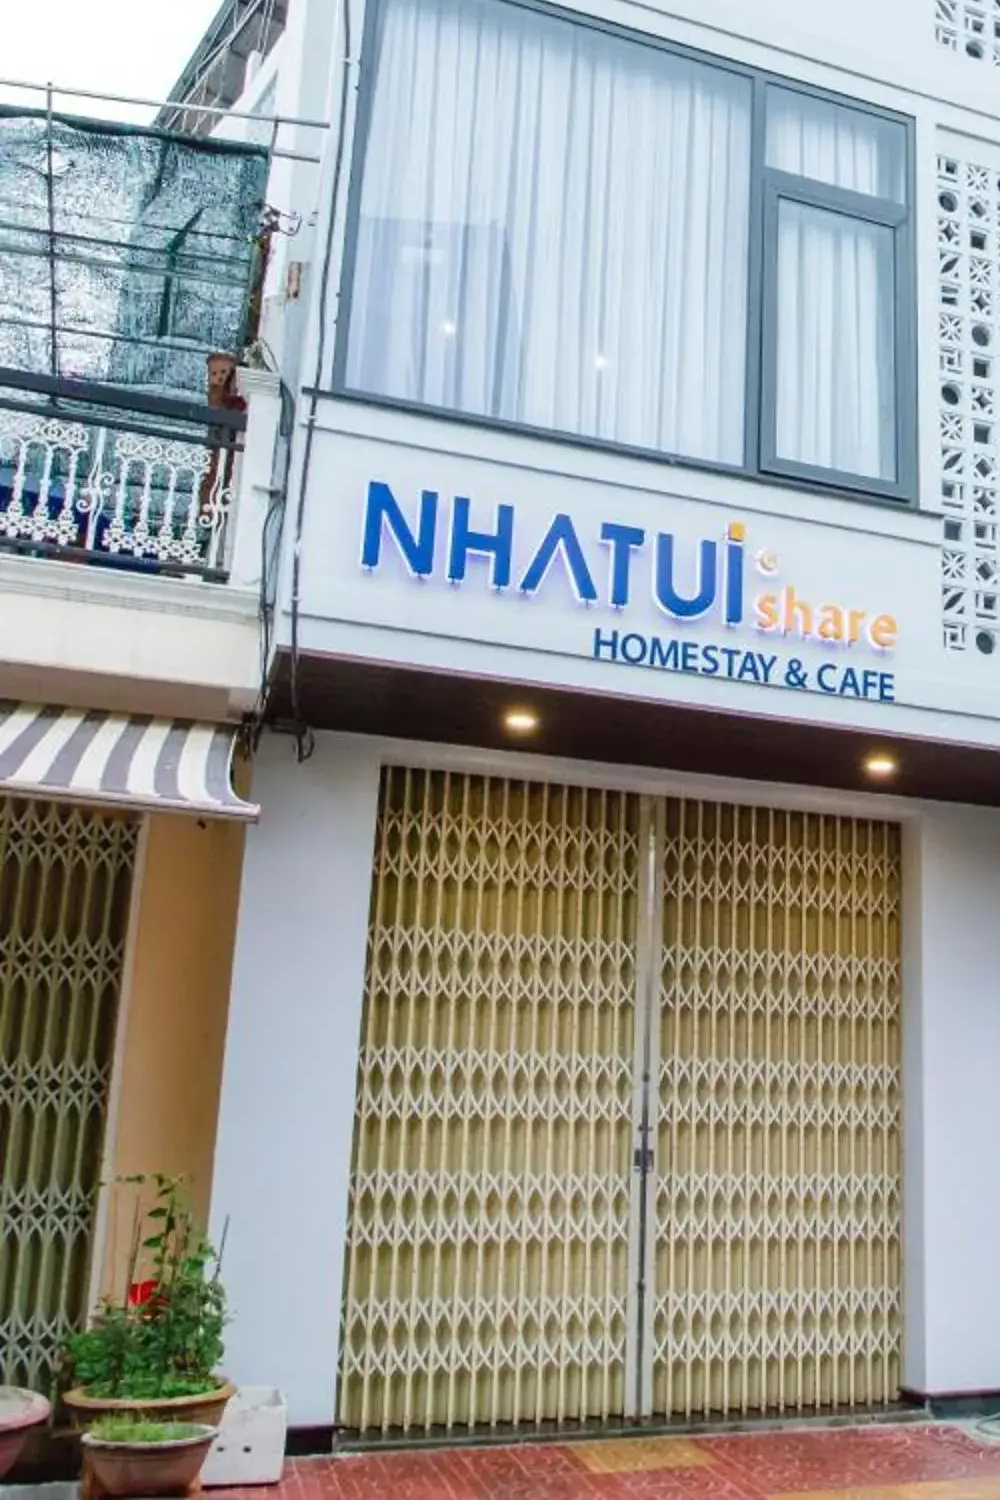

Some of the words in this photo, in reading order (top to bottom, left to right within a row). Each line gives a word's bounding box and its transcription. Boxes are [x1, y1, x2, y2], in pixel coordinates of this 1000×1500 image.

[757, 584, 898, 647] share
[594, 627, 777, 682] HOMESTAY
[784, 658, 808, 688] &
[817, 663, 895, 701] CAFE
